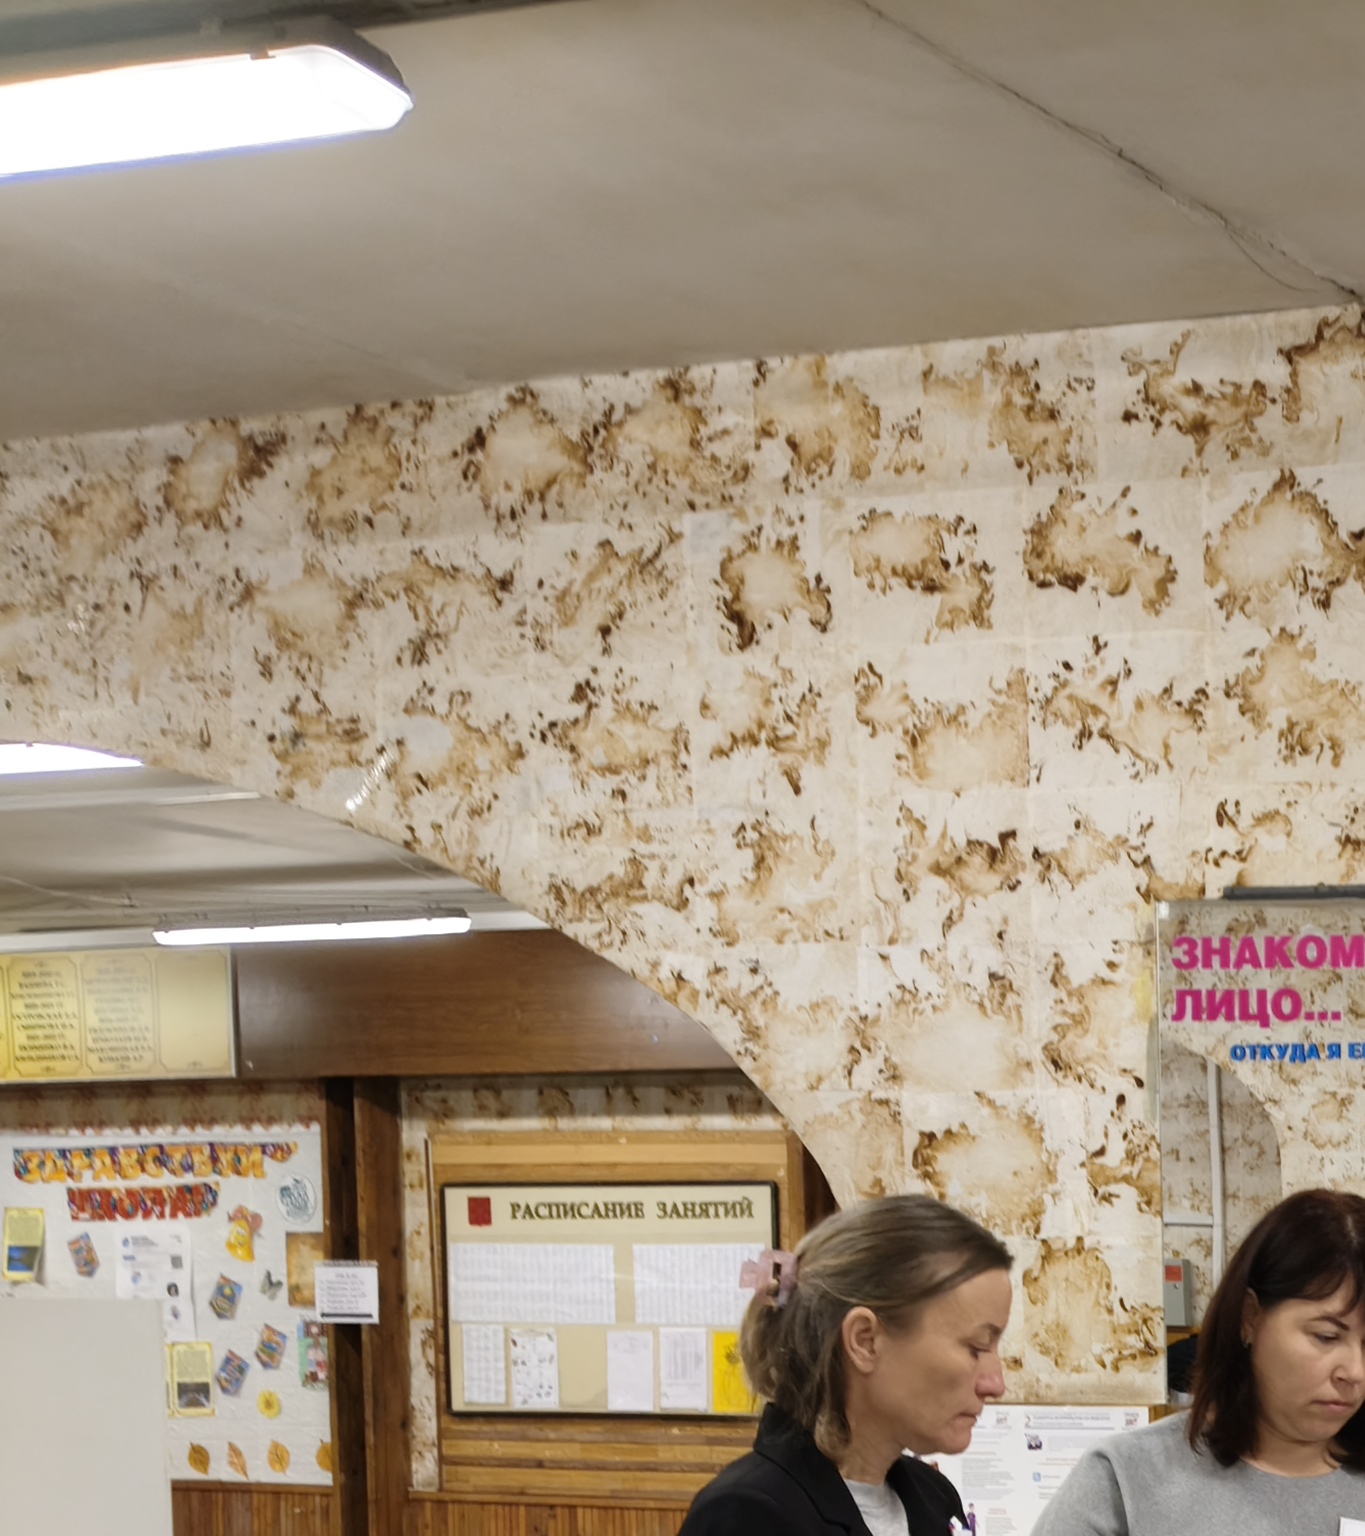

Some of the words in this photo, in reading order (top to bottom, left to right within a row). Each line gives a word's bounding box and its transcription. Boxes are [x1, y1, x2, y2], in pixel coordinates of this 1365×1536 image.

[1171, 988, 1342, 1028] ЛИЦО...
[1230, 1043, 1321, 1064] ОТКУДА
[1327, 1043, 1341, 1060] Я
[510, 1202, 645, 1220] РАСПИСАНИЕ
[656, 1196, 754, 1219] ЗАНЯТИЙ
